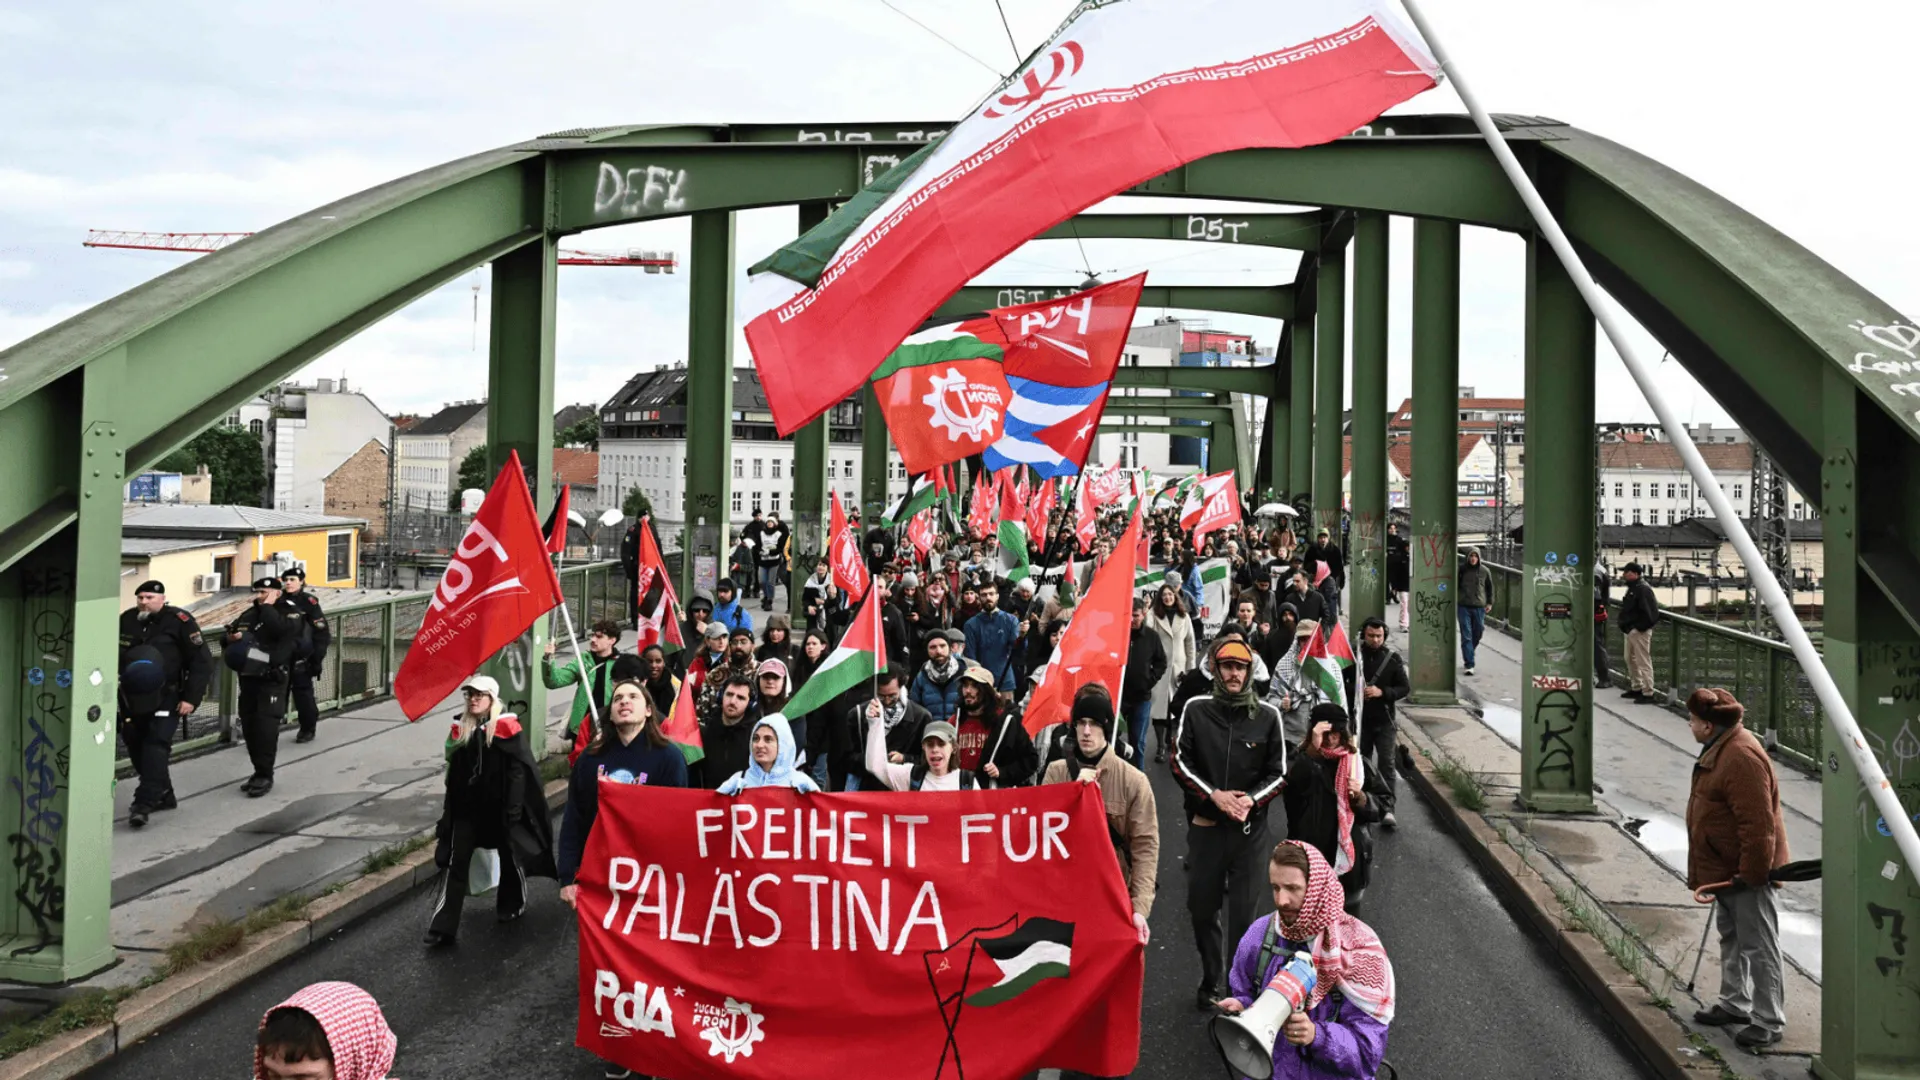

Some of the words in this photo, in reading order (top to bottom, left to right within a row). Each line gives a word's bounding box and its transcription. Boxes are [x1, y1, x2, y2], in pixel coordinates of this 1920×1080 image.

[696, 803, 928, 868] FREIHEIT
[960, 806, 1070, 864] FÜR
[602, 856, 948, 955] PALÄSTINA
[693, 1001, 728, 1017] JUGEND
